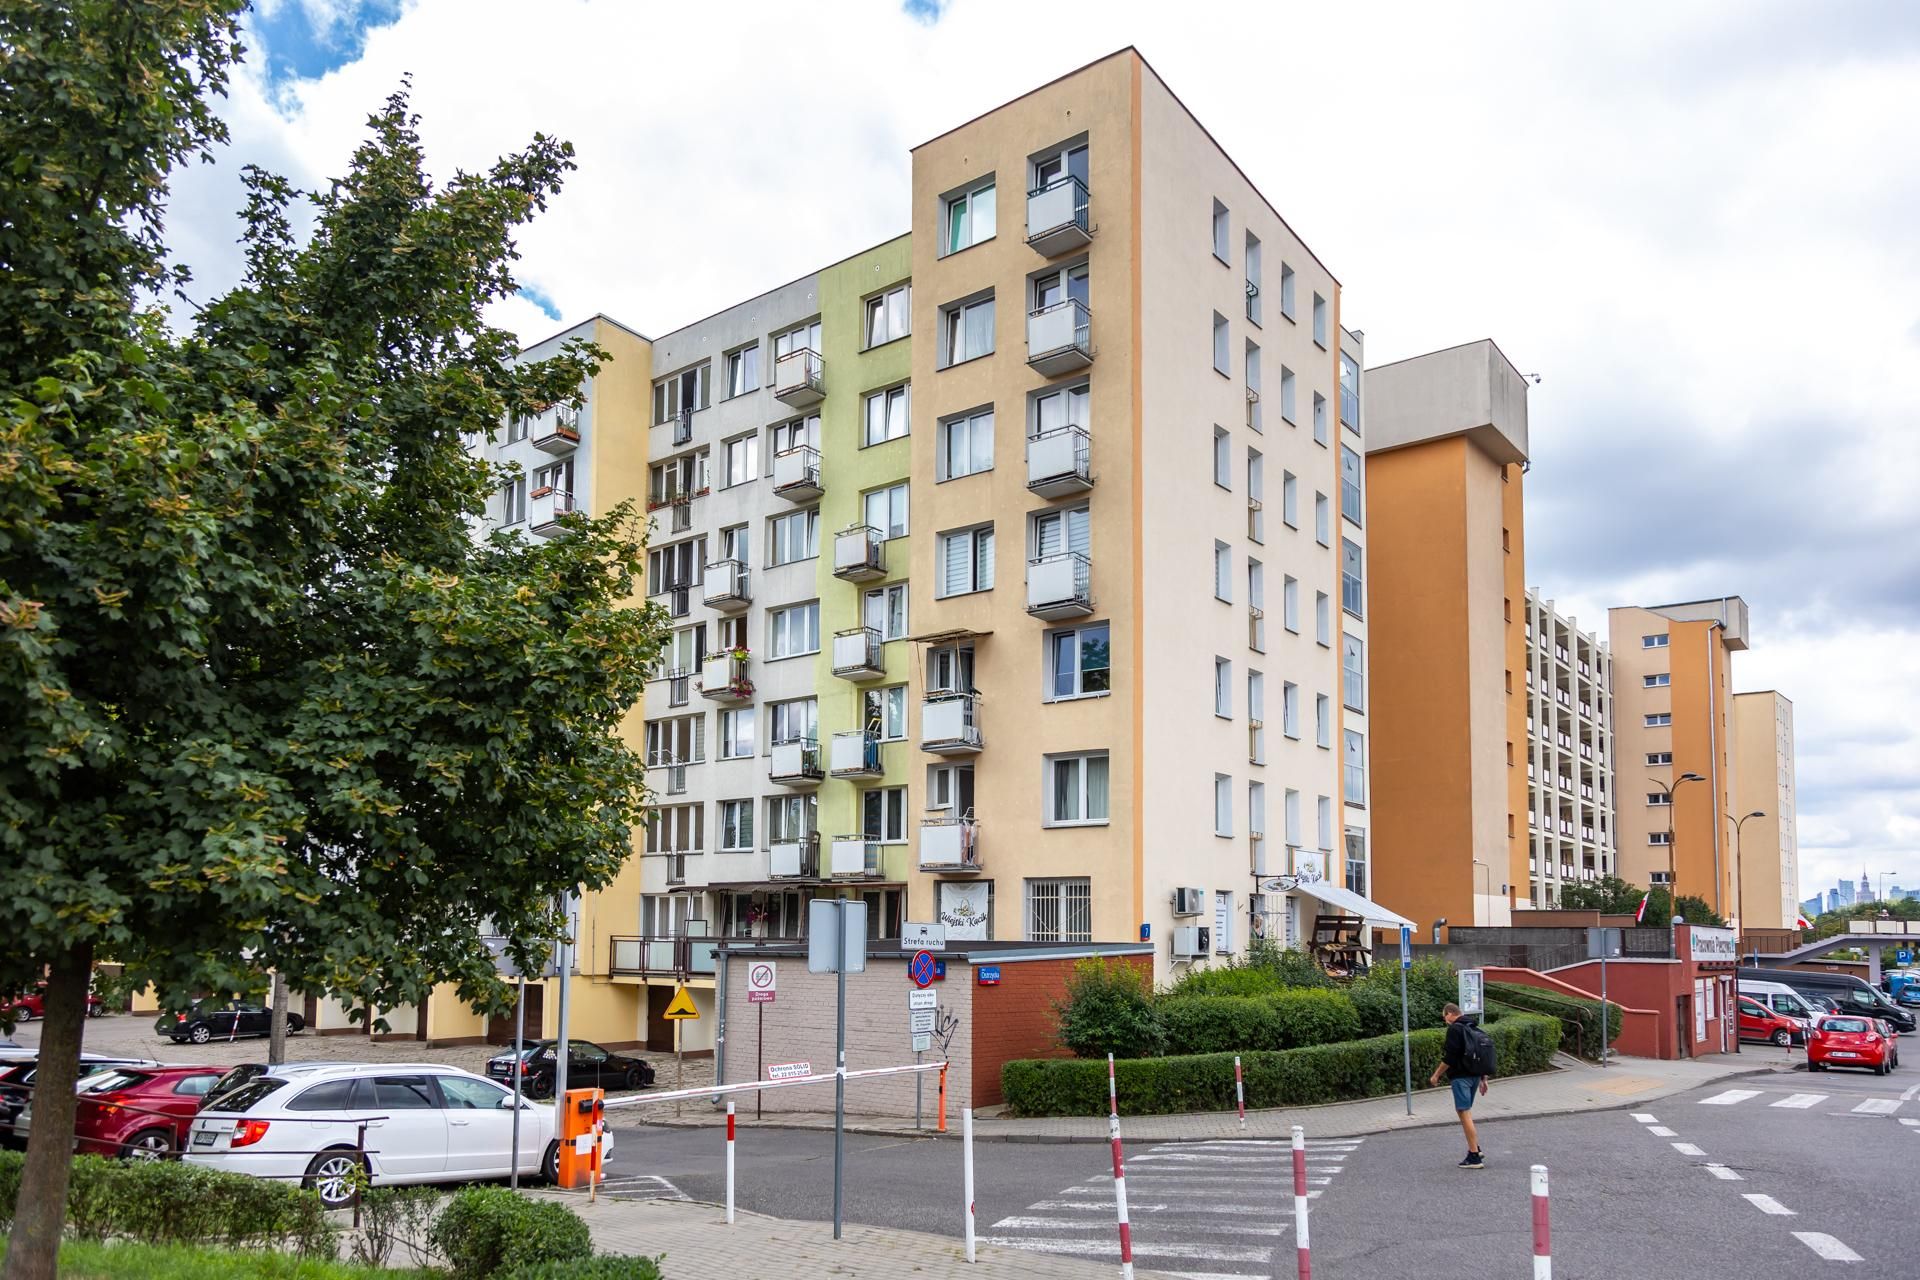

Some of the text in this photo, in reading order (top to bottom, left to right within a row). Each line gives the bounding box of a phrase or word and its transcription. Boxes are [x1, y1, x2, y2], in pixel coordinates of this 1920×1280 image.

[941, 911, 987, 928] Wiejski Kącik
[903, 937, 924, 945] Strefa
[1899, 951, 1906, 959] P
